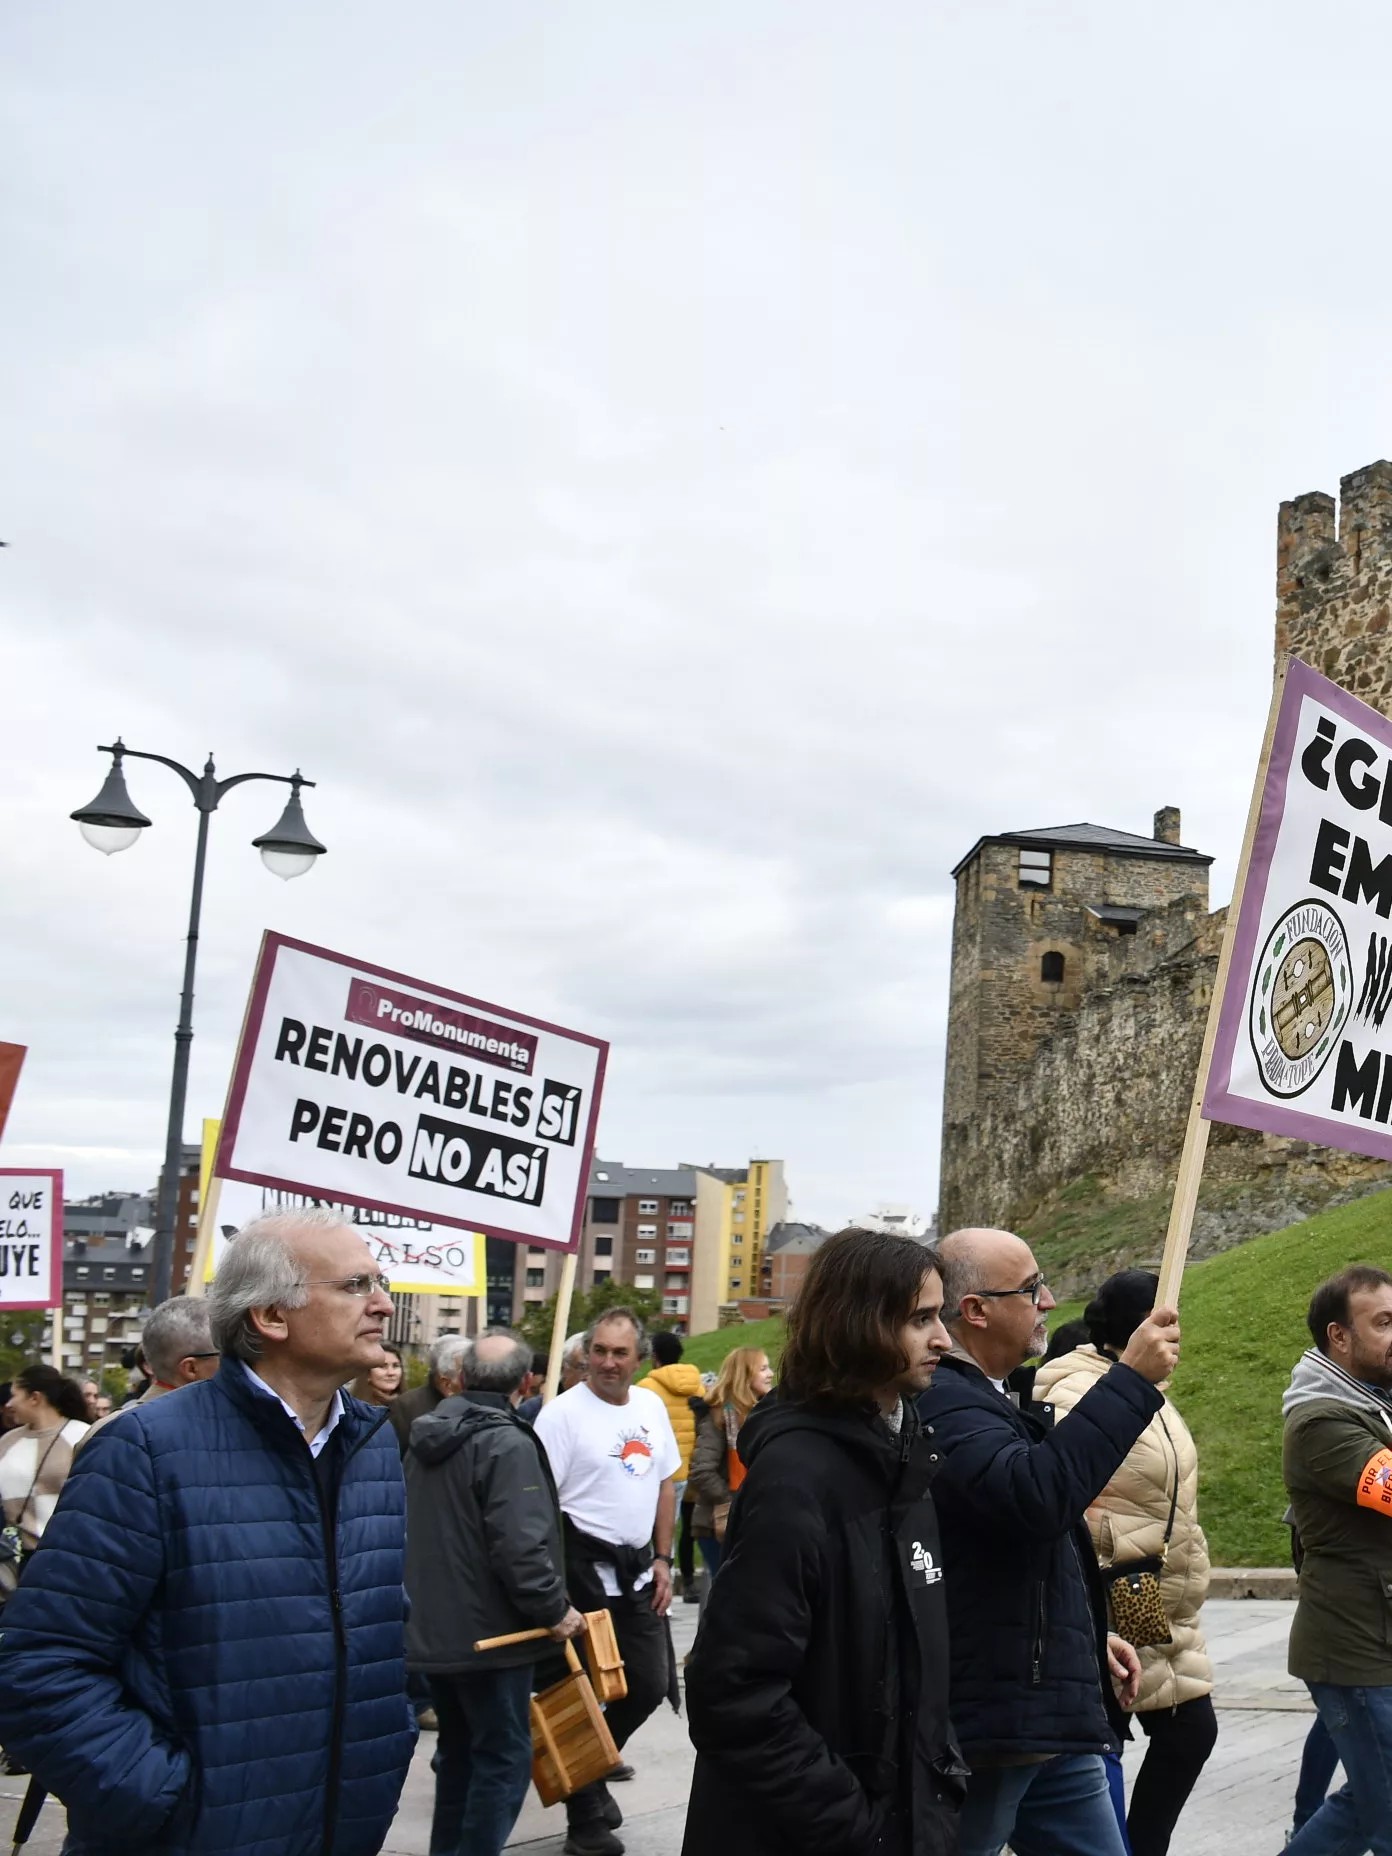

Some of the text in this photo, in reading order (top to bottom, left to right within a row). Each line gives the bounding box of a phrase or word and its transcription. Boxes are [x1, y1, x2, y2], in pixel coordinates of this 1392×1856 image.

[1285, 908, 1344, 961] FUNDACIÓN
[376, 998, 530, 1064] ProMonumenta
[275, 1016, 533, 1128] RENOVABLES
[537, 1088, 581, 1141] SÍ
[1286, 1052, 1315, 1089] TOPE
[289, 1099, 544, 1203] PERO NO ASÍ
[9, 1190, 43, 1212] QUE
[366, 1243, 465, 1267] ALSO
[1362, 1454, 1392, 1494] POR EL
